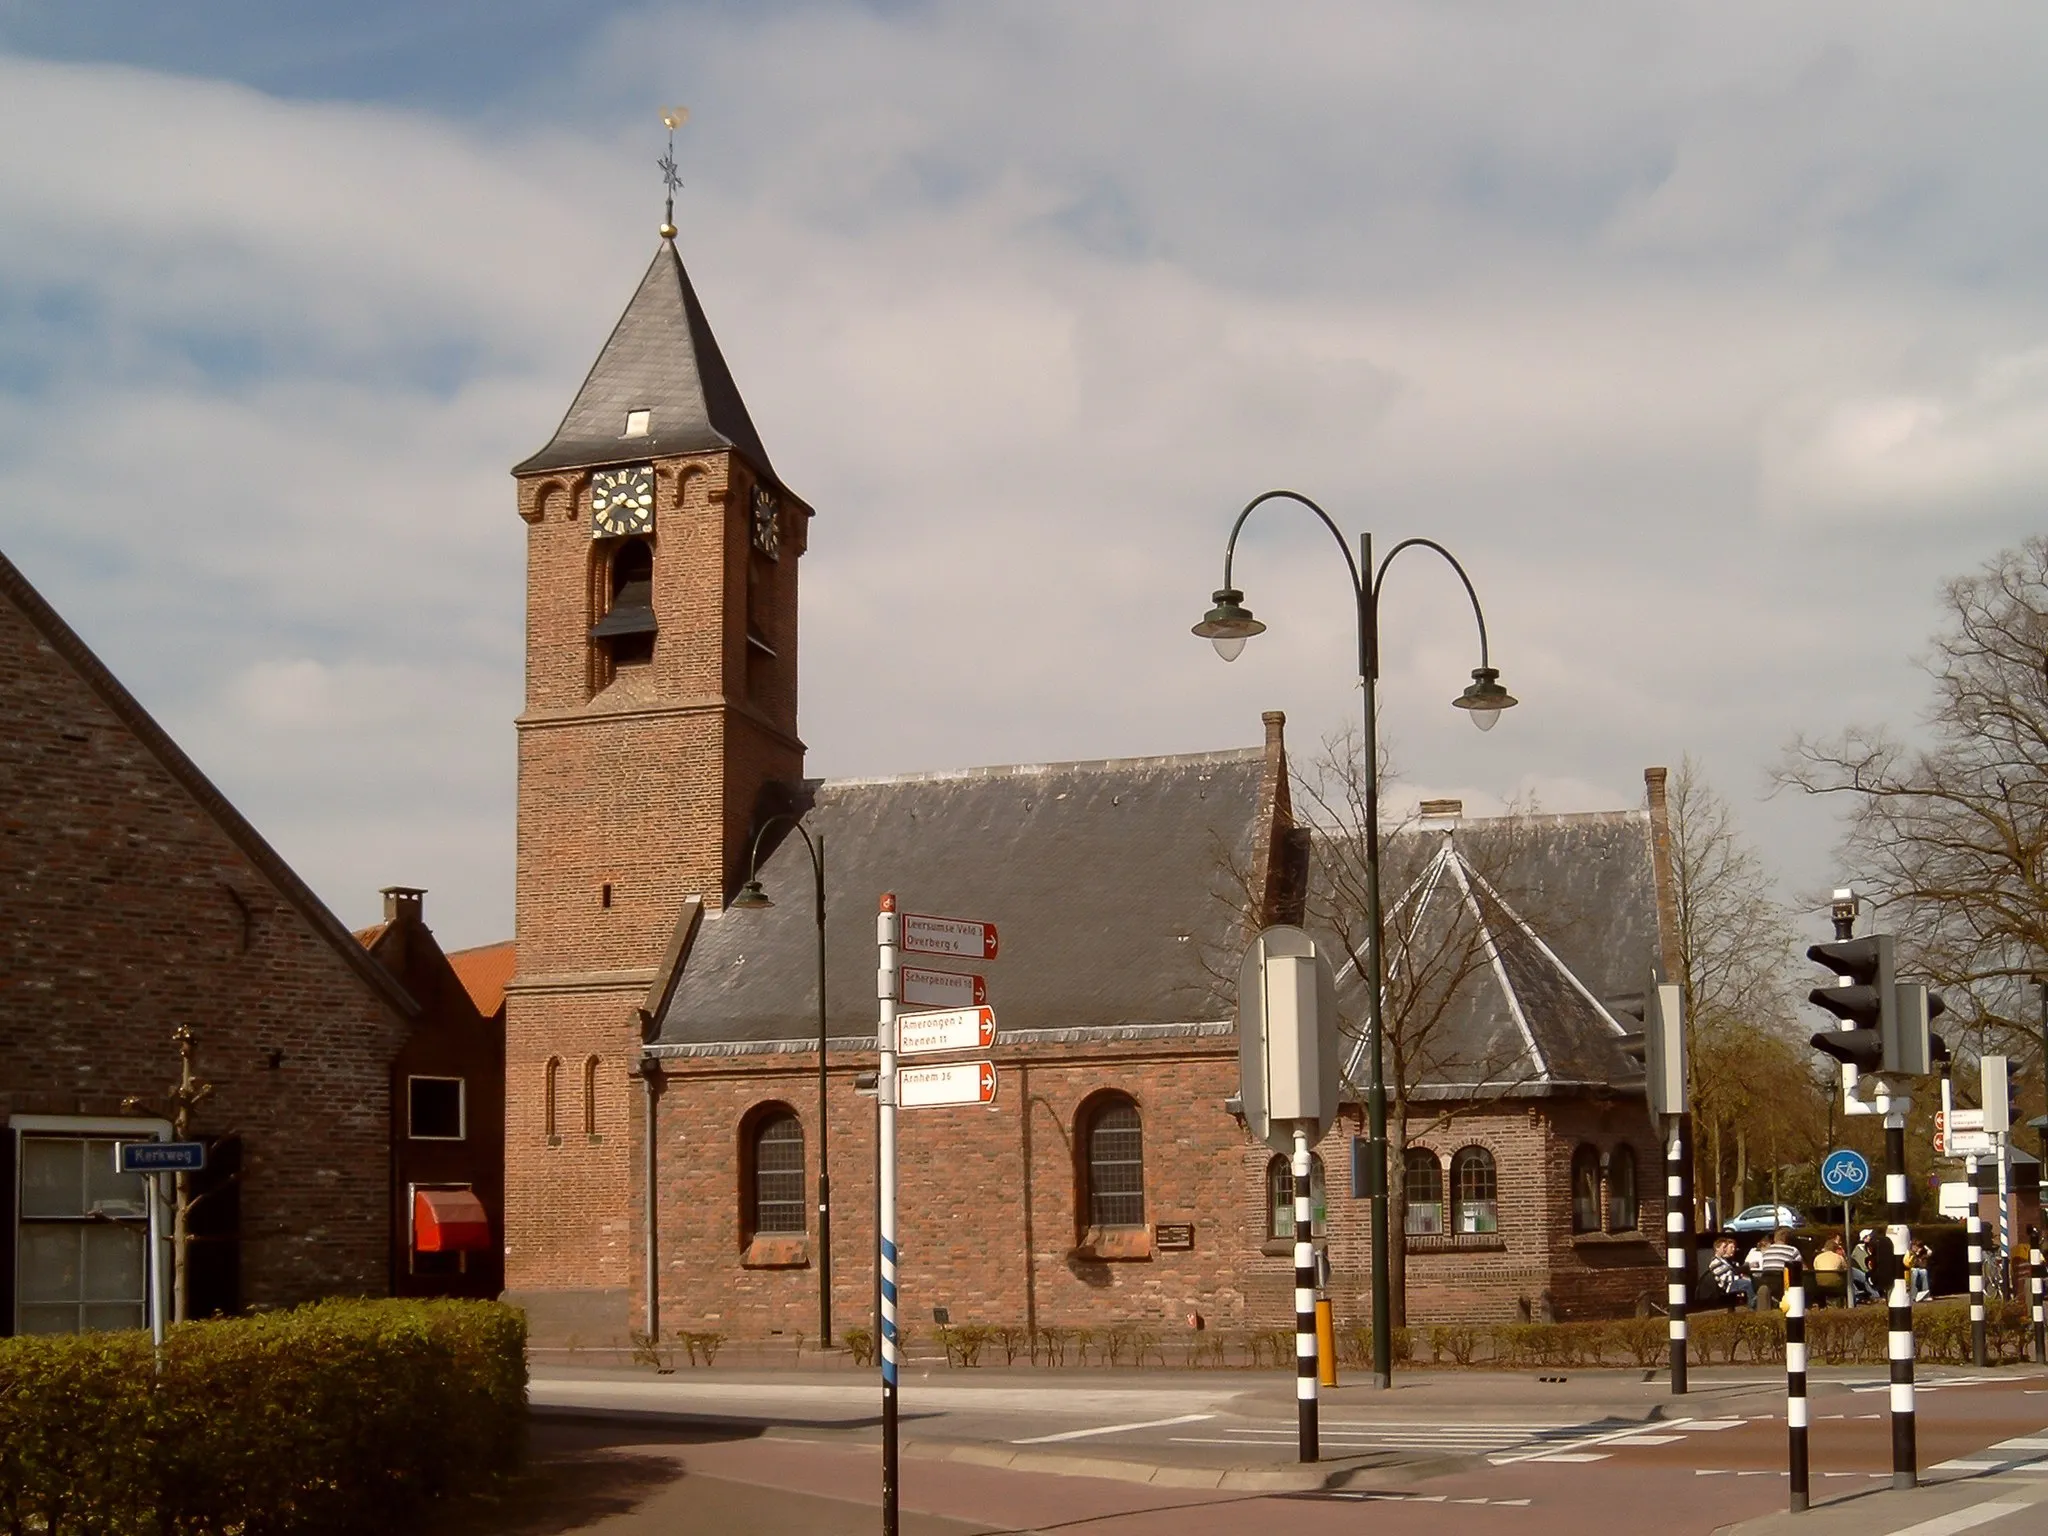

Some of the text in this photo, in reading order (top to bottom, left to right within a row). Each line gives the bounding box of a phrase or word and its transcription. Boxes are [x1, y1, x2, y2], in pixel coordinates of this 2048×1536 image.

[907, 934, 951, 951] Overberg
[906, 971, 962, 988] Scherpenzeel
[903, 1015, 963, 1030] Amerongen 2
[903, 1035, 937, 1047] Rhenen
[903, 1073, 939, 1084] Arnhem
[134, 1148, 192, 1164] Kerkweg
